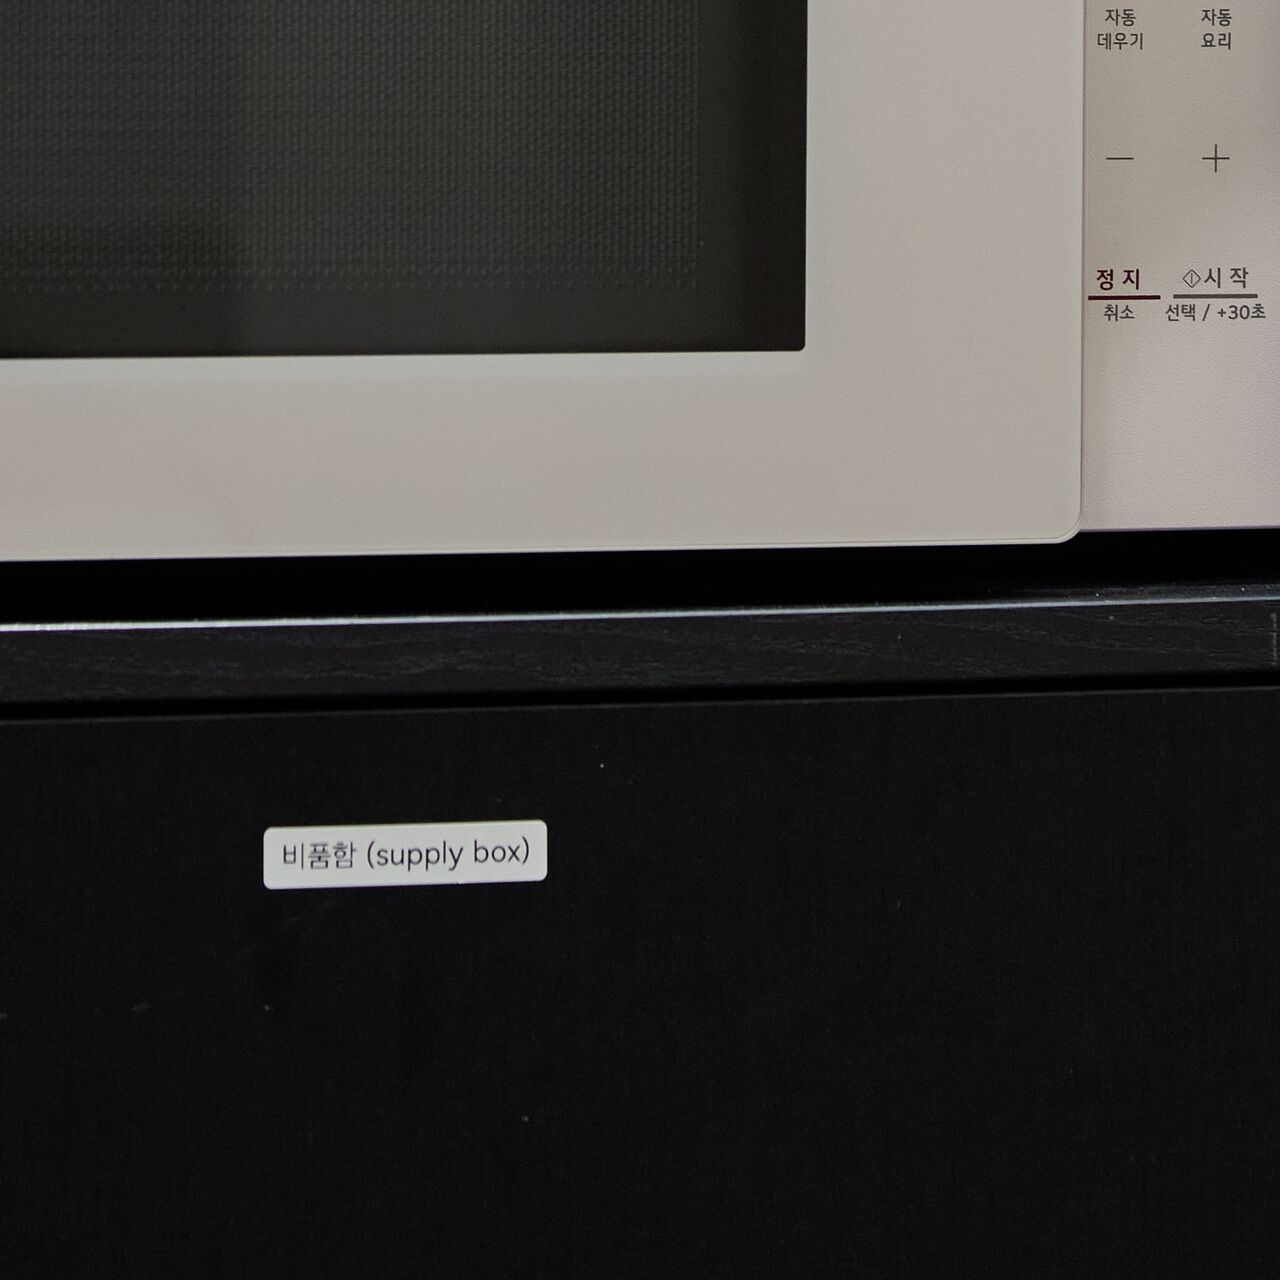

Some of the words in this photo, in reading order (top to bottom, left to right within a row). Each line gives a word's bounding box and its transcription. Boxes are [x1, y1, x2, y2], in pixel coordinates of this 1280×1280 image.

[1104, 8, 1136, 26] 자동
[1201, 8, 1233, 26] 자동
[1097, 32, 1144, 50] 데우기
[1201, 32, 1232, 50] 요리
[1104, 304, 1135, 321] 취소
[1165, 304, 1196, 321] 선택
[1217, 304, 1266, 320] +30초
[282, 841, 357, 870] 비품함
[367, 840, 463, 871] (supply
[473, 836, 529, 865] box)
